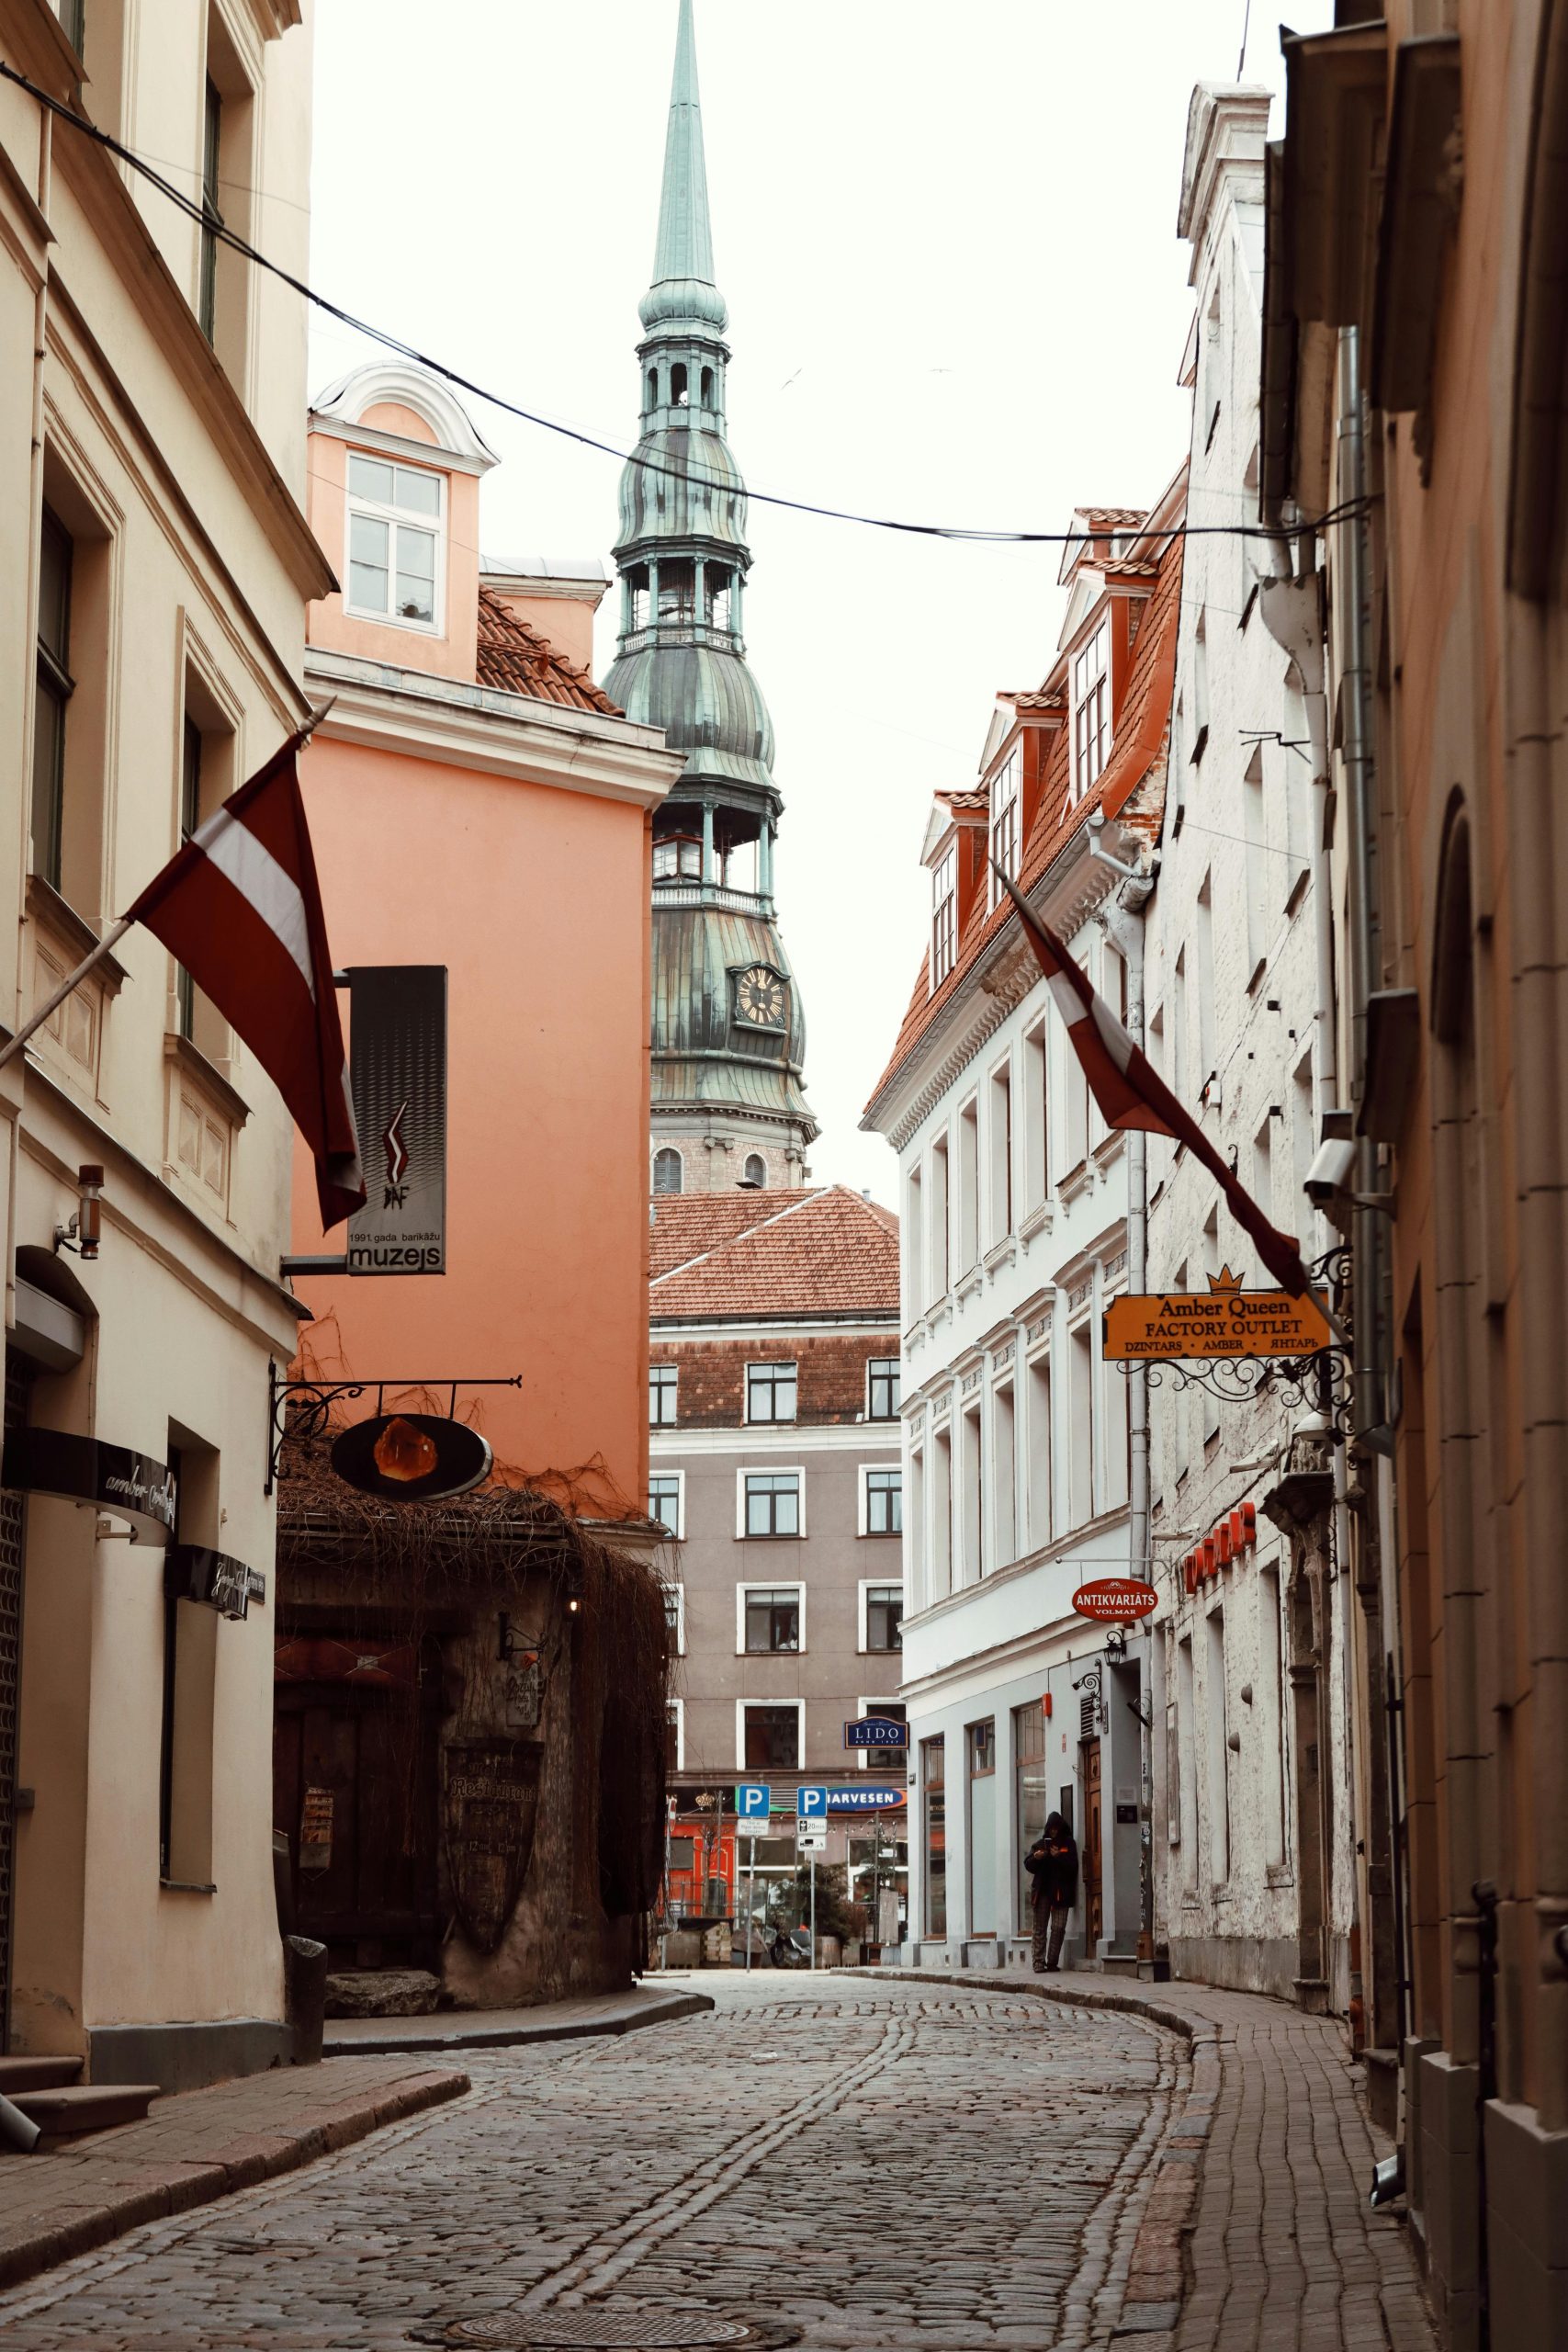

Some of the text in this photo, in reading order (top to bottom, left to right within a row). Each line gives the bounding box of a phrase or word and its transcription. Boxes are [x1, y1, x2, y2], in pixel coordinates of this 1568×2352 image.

[374, 1233, 397, 1243] gada
[349, 1245, 440, 1271] muzejs
[1158, 1297, 1291, 1318] Amber Queen
[1145, 1319, 1303, 1338] FACTORY OUTLET
[1124, 1338, 1319, 1352] DZINTARS AMBER ЯНТАРЬ
[1077, 1591, 1155, 1606] ANTIKVARIĀTS
[855, 1727, 898, 1739] LIDO
[450, 1777, 538, 1803] Restaurant
[745, 1789, 763, 1814] P
[804, 1790, 820, 1815] P
